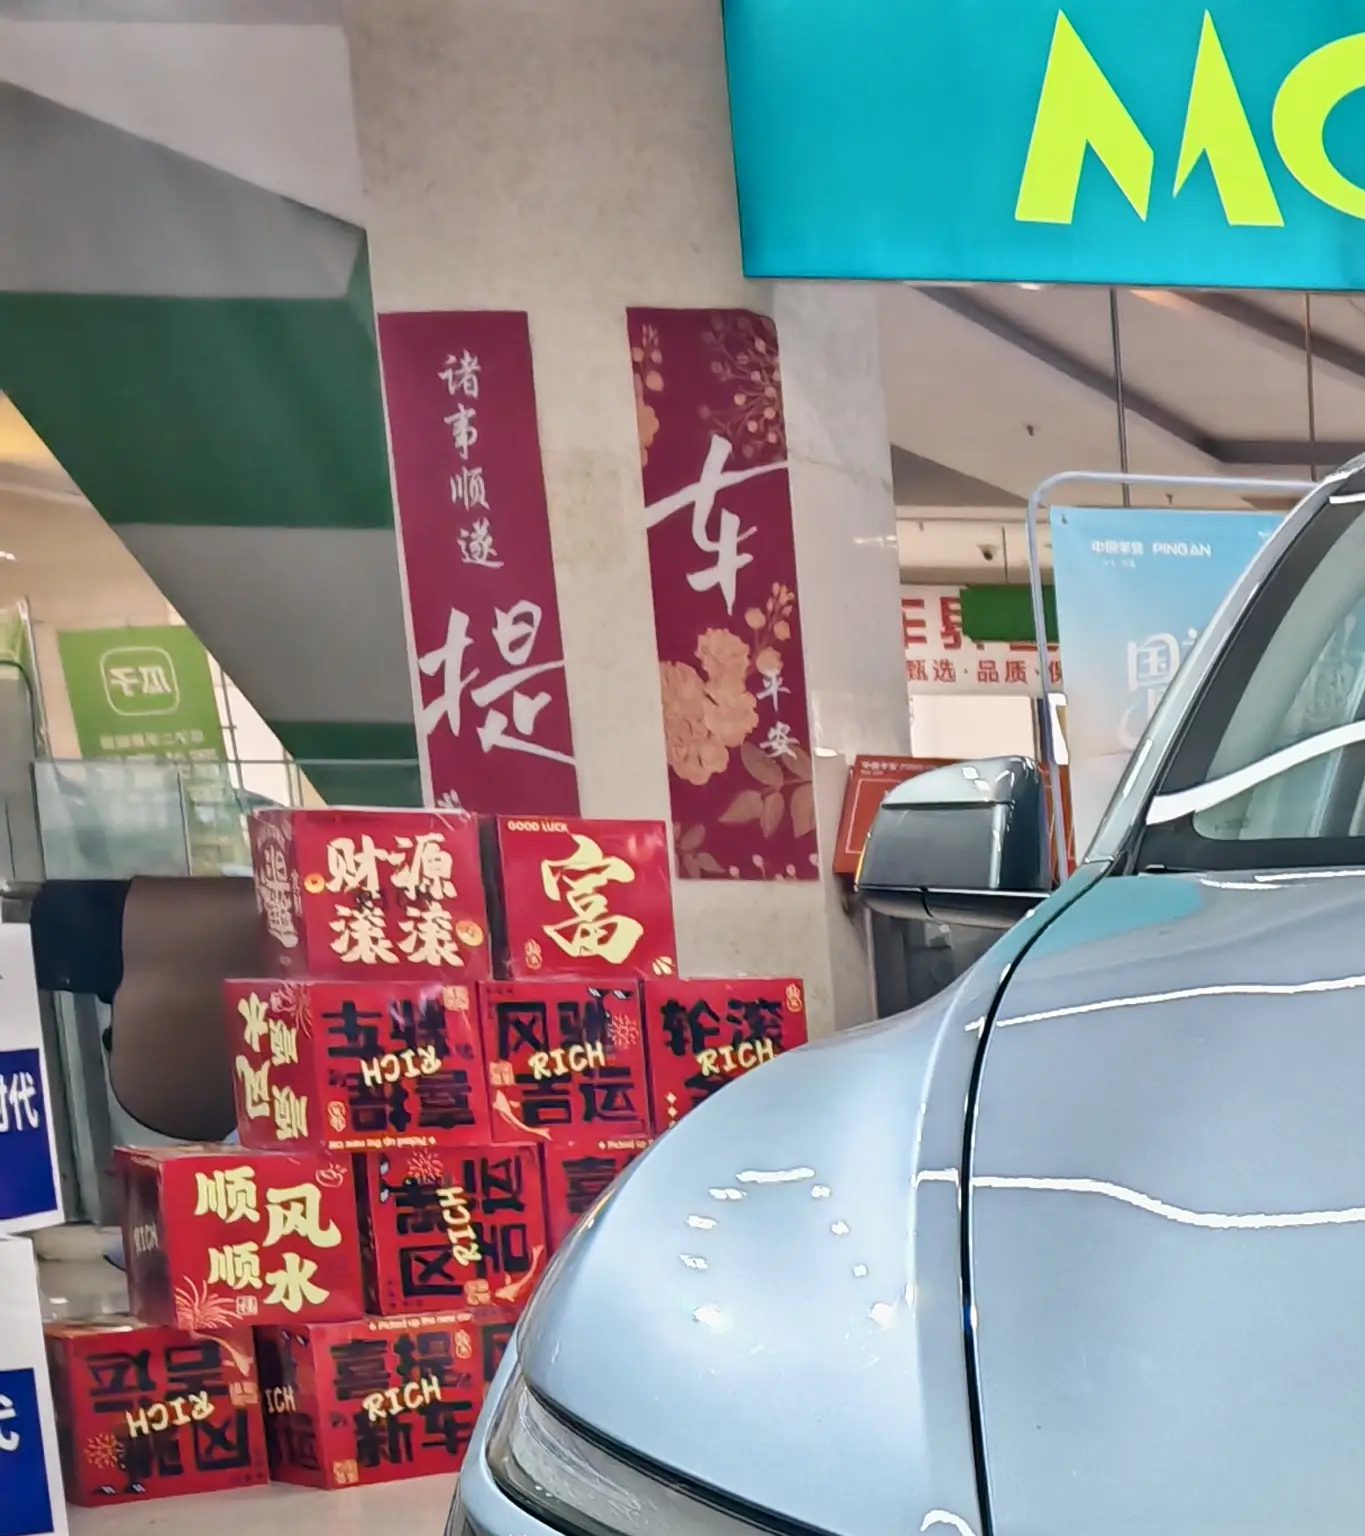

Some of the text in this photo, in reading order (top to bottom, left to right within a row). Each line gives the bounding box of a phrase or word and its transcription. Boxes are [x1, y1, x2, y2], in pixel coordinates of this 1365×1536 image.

[438, 350, 505, 569] 诸事顺遂
[638, 433, 790, 616] 车
[416, 600, 577, 767] 提
[757, 667, 799, 759] 平安
[507, 820, 568, 833] GOOD LUCK
[540, 833, 645, 965] 富
[361, 1044, 442, 1087] RICH
[528, 1041, 605, 1080] RICH
[696, 1037, 775, 1076] RICH
[435, 1185, 483, 1267] RICH
[125, 1390, 215, 1439] RICH
[362, 1374, 443, 1423] RICH
